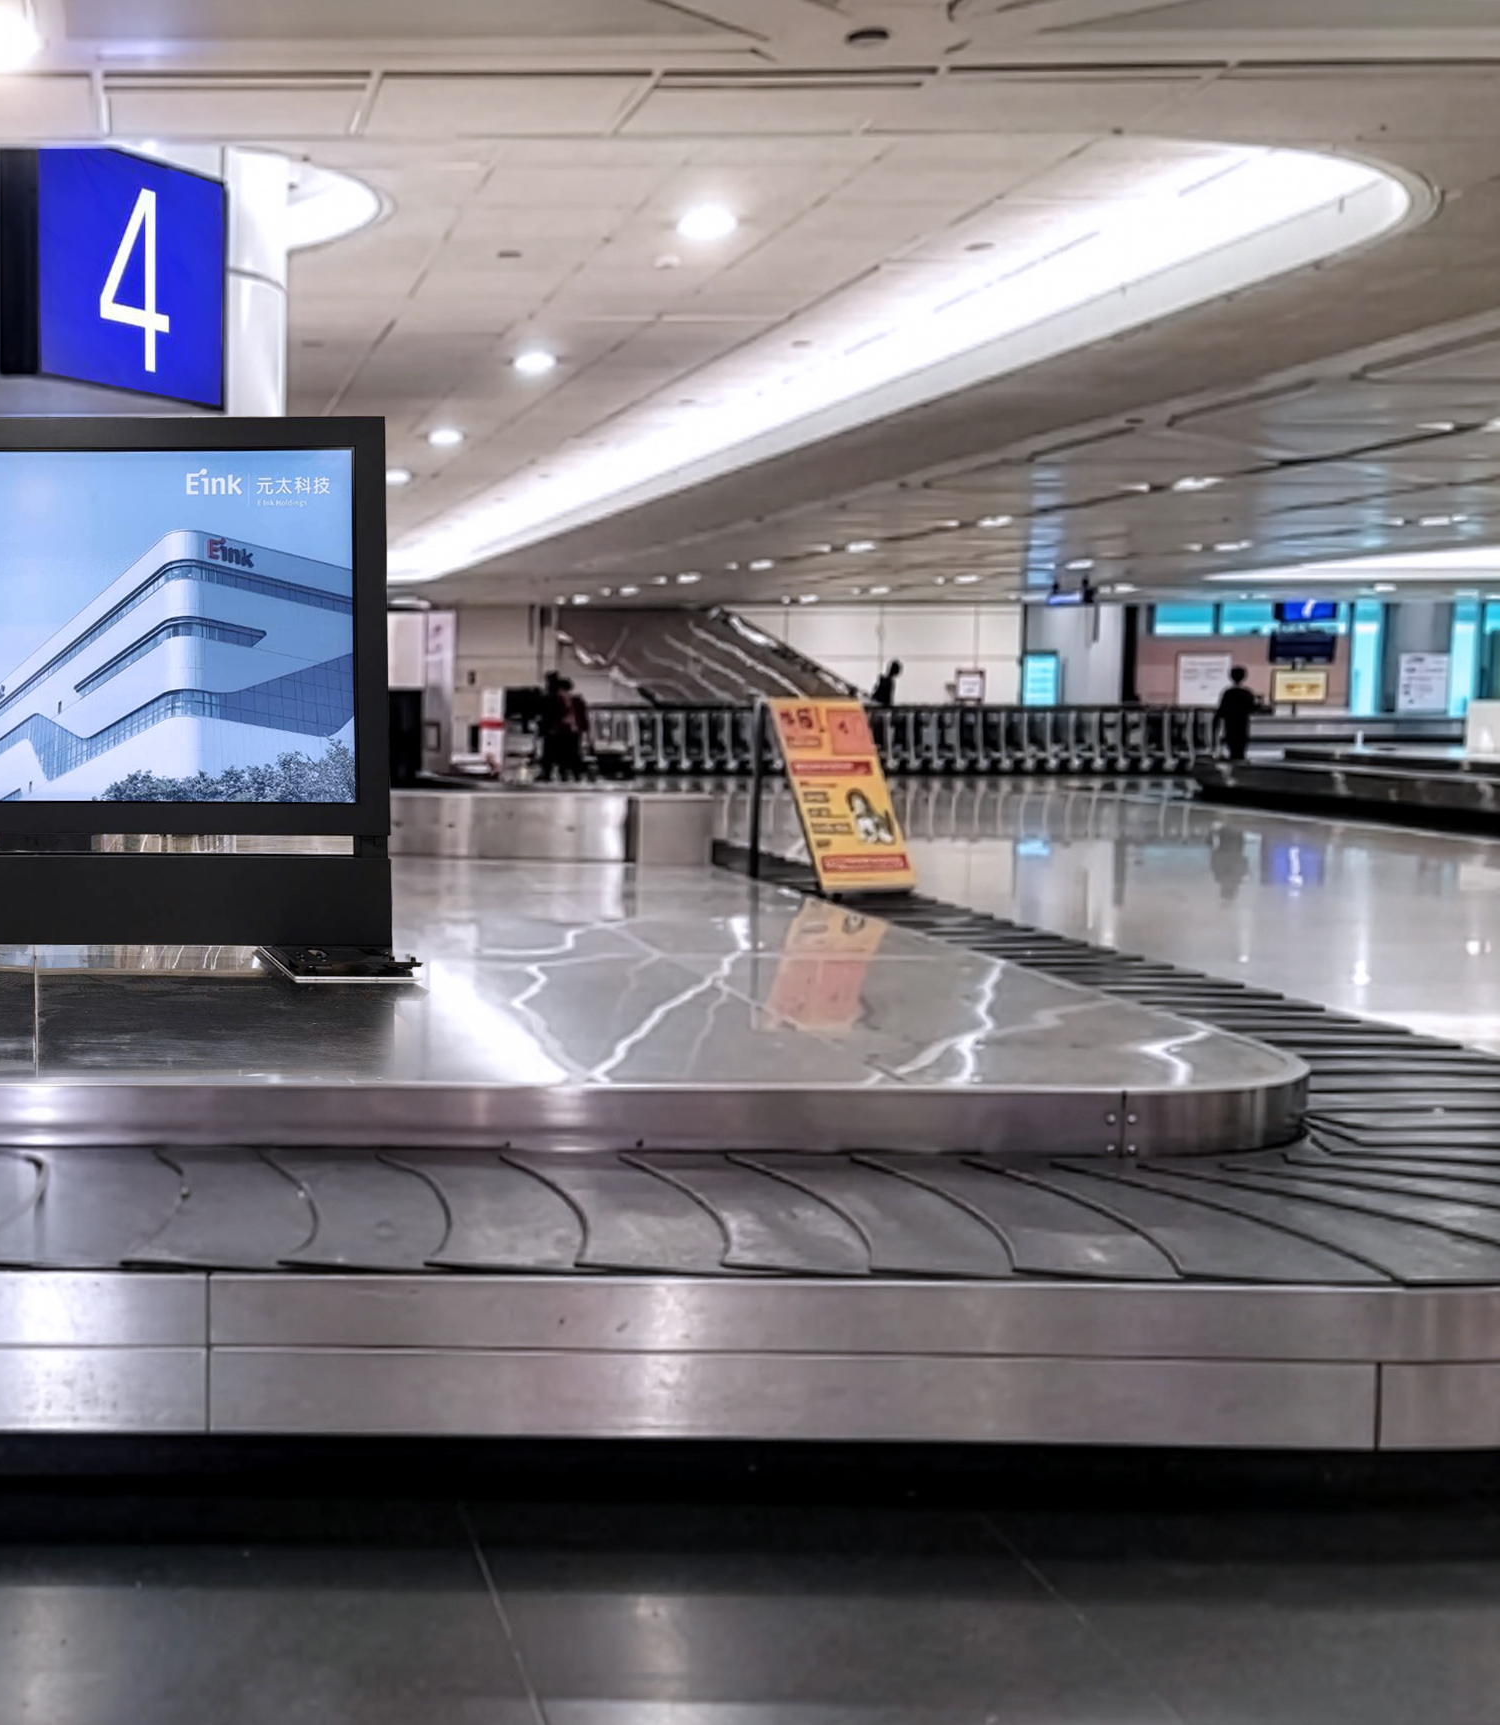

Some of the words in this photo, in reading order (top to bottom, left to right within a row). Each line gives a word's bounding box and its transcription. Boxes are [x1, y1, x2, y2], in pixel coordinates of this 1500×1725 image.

[100, 187, 170, 373] 4
[256, 476, 331, 495] 元太科技
[275, 499, 306, 508] Holdings
